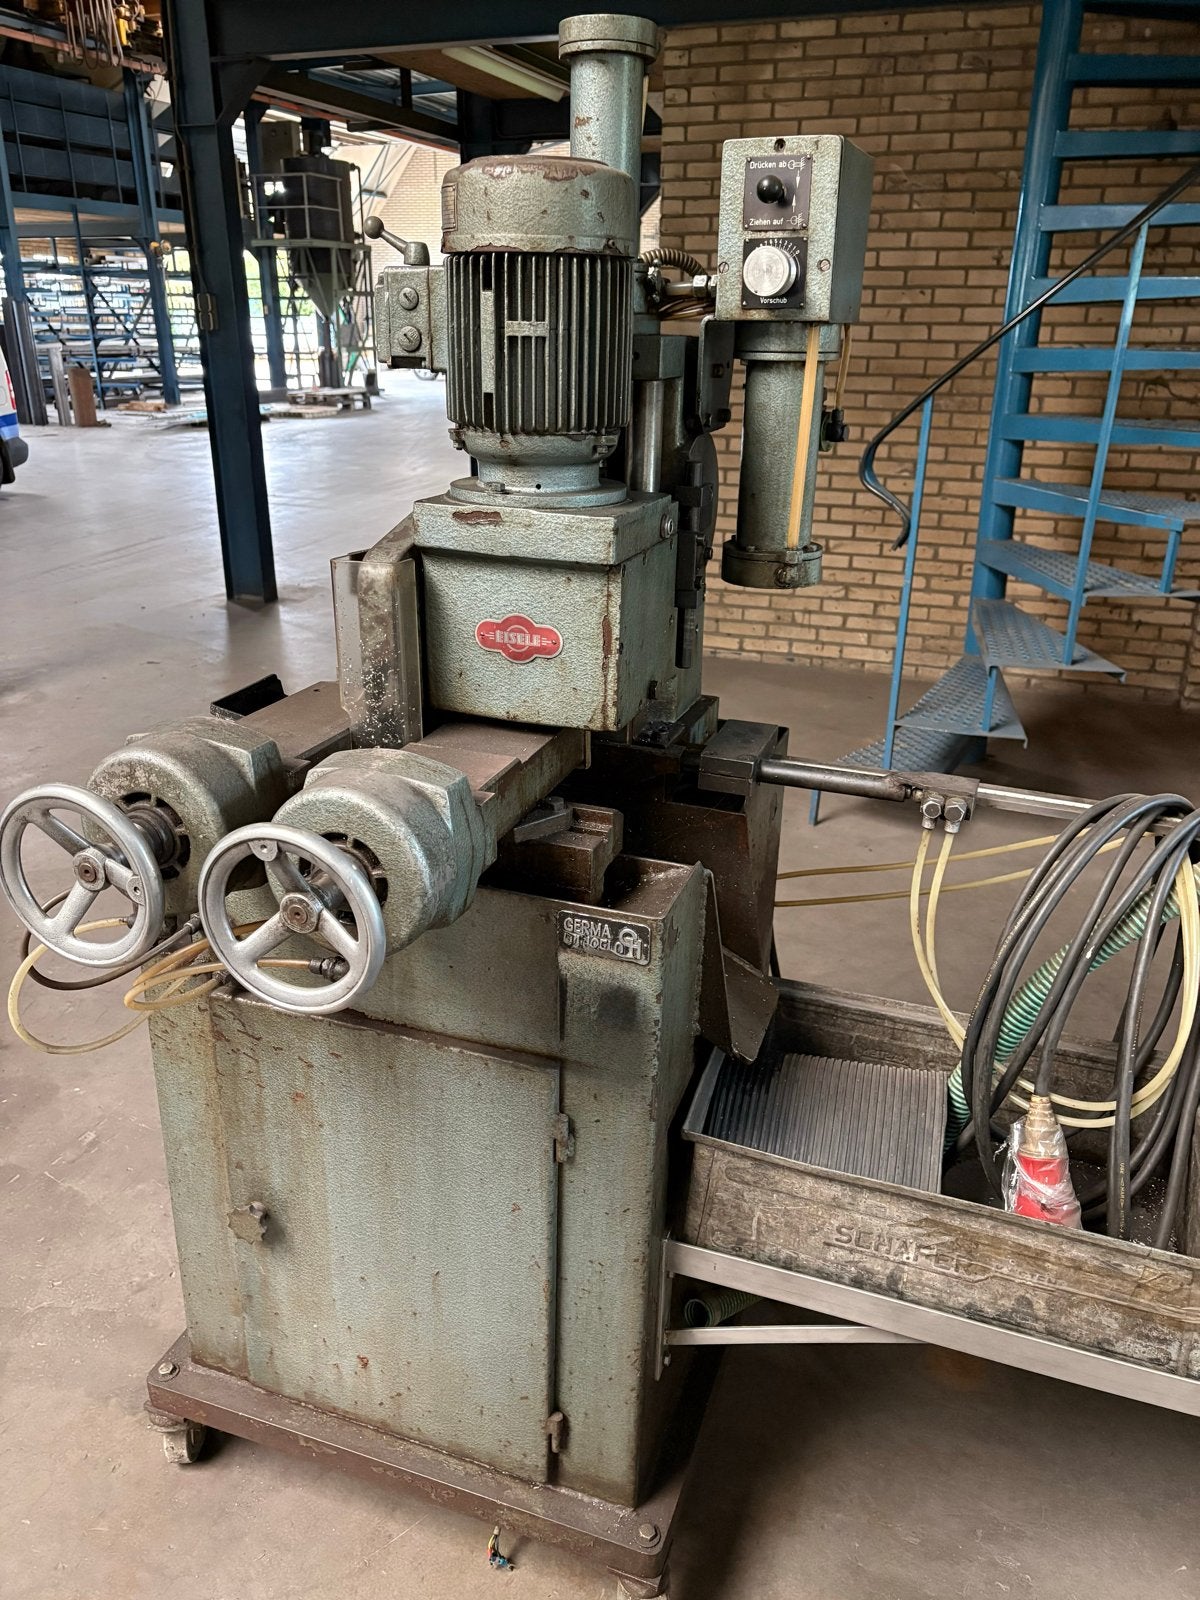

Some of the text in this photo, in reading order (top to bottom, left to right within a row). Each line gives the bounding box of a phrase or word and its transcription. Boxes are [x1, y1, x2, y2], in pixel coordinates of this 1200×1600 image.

[750, 160, 787, 169] Drücken ab
[749, 217, 784, 226] Ziehen auf
[495, 630, 541, 647] EISELE
[563, 917, 611, 939] GERMA
